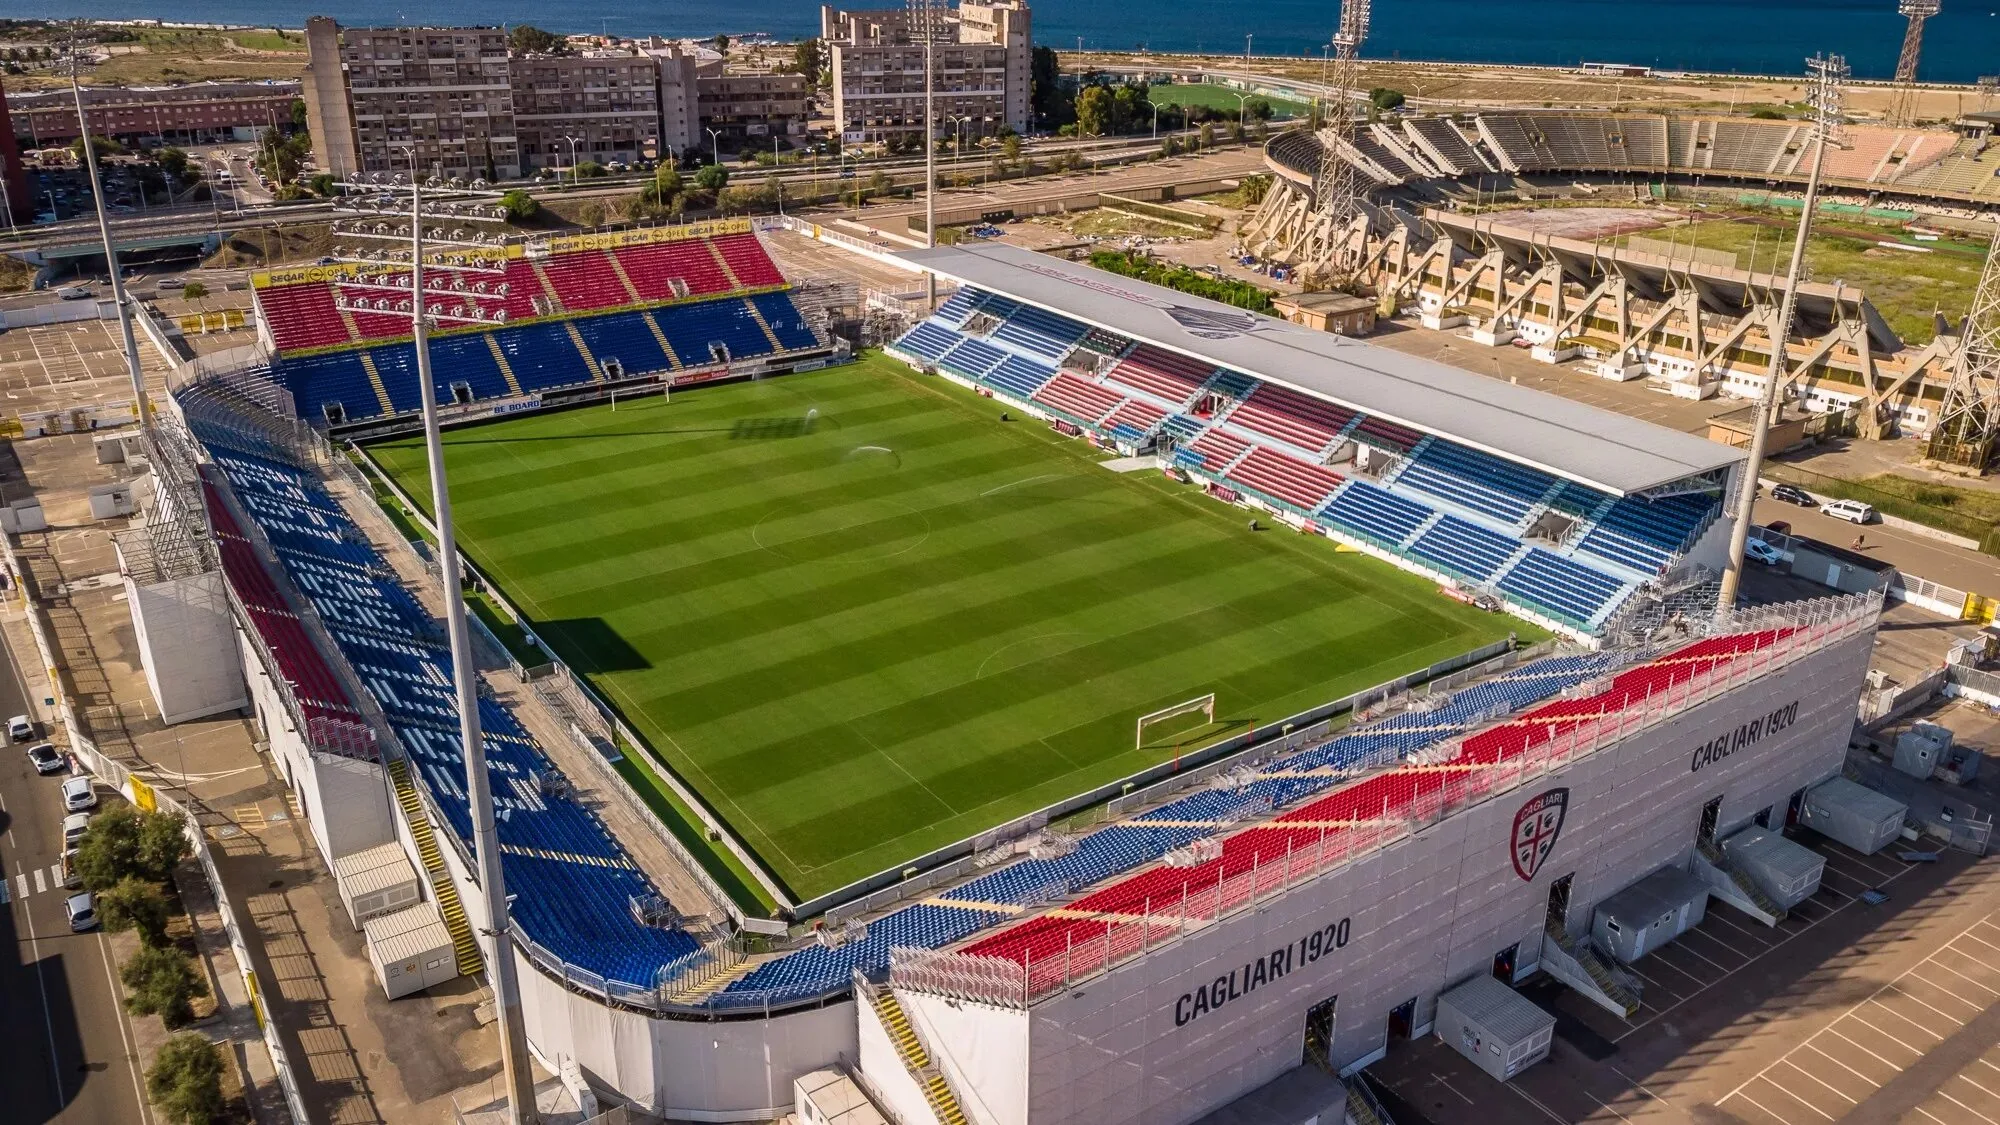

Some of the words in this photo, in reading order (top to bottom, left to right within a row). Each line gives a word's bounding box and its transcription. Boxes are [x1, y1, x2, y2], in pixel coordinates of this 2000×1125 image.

[551, 241, 579, 251] SECAR
[597, 237, 618, 246] OPEL
[621, 233, 648, 243] SECAR
[666, 229, 685, 238] OPEL
[688, 226, 715, 236] SECAR
[731, 222, 749, 231] OPEL
[270, 272, 305, 283] SECAR
[355, 263, 387, 274] SECAR
[485, 250, 508, 259] OPEL
[494, 406, 505, 414] BE
[508, 400, 540, 412] BOARD
[1691, 716, 1765, 773] CAGLIARI
[1765, 700, 1799, 737] 1920
[1521, 793, 1563, 820] CAGLIARI
[1175, 943, 1293, 1027] CAGLIARI
[1300, 917, 1351, 968] 1920
